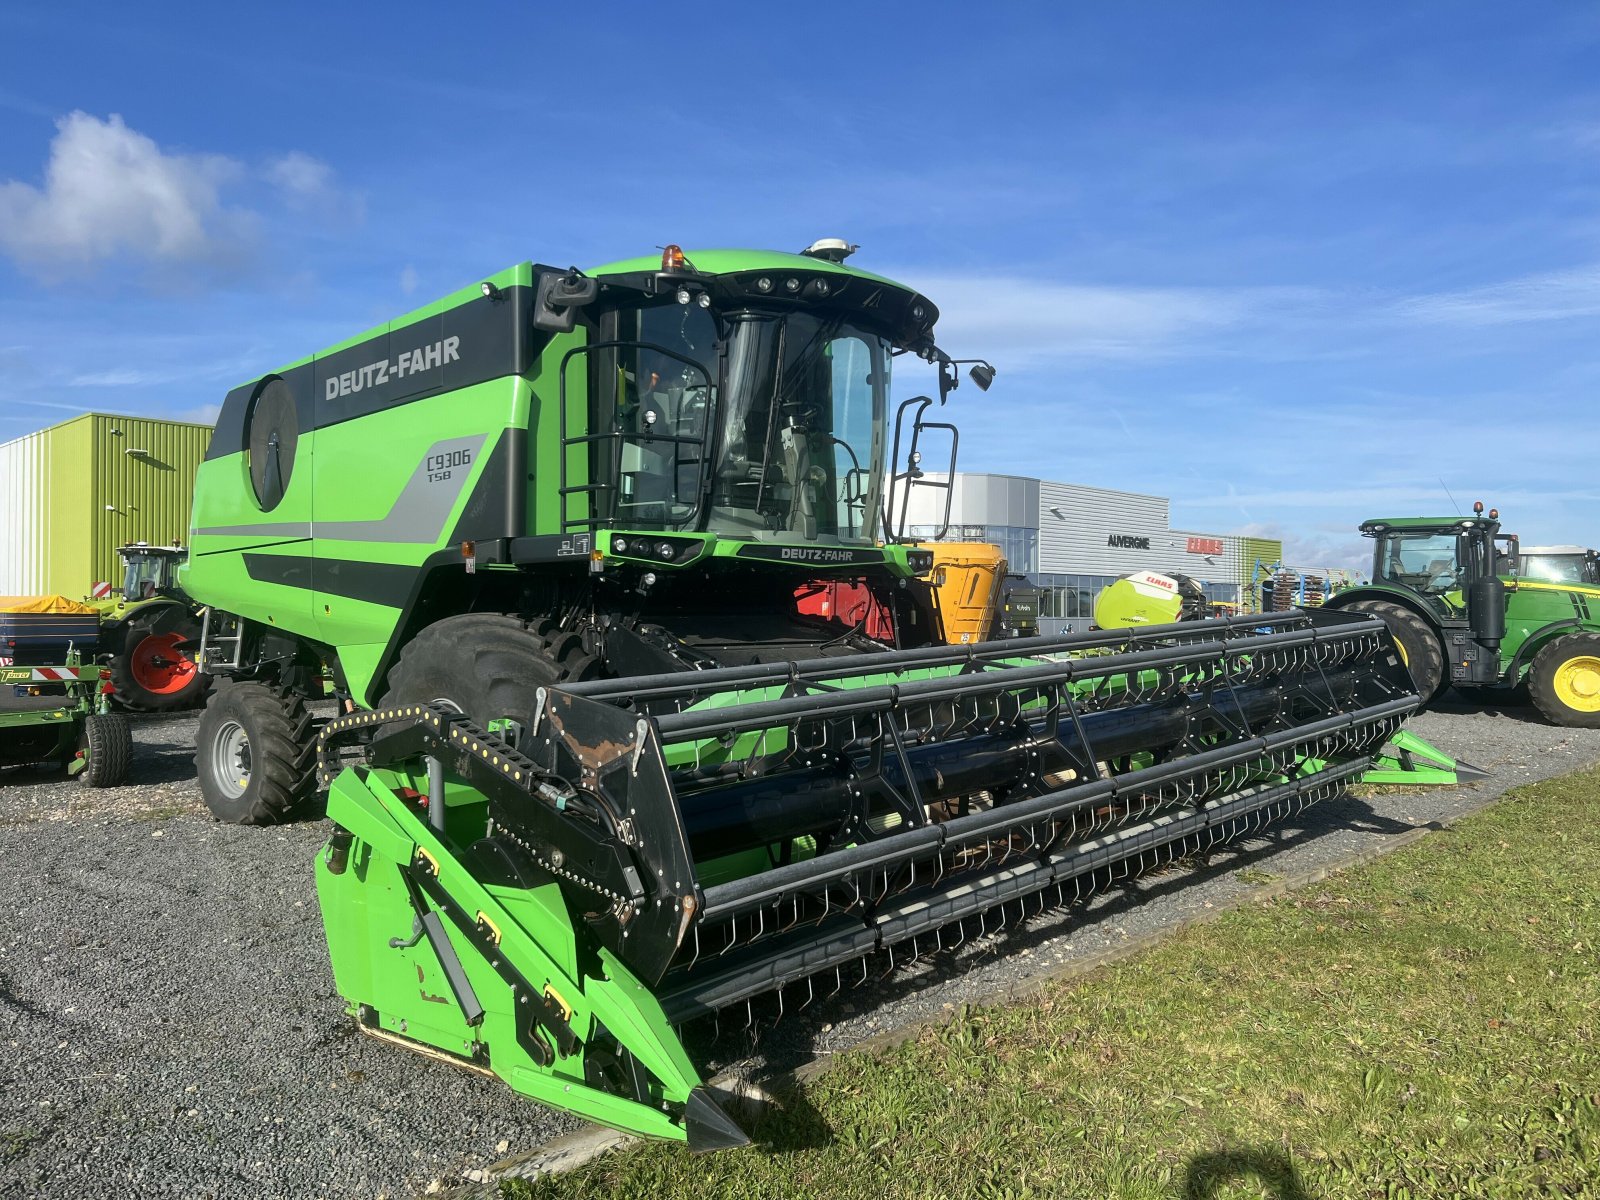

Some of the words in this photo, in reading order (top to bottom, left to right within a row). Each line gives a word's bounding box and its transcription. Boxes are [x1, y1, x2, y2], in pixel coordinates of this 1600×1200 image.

[325, 335, 461, 401] DEUTZ-FAHR
[427, 448, 471, 472] C9306
[427, 470, 452, 483] TSB
[1107, 534, 1150, 550] AUVERGNE
[781, 548, 854, 561] DEUTZ-FAHR
[1145, 576, 1174, 590] CLAAS
